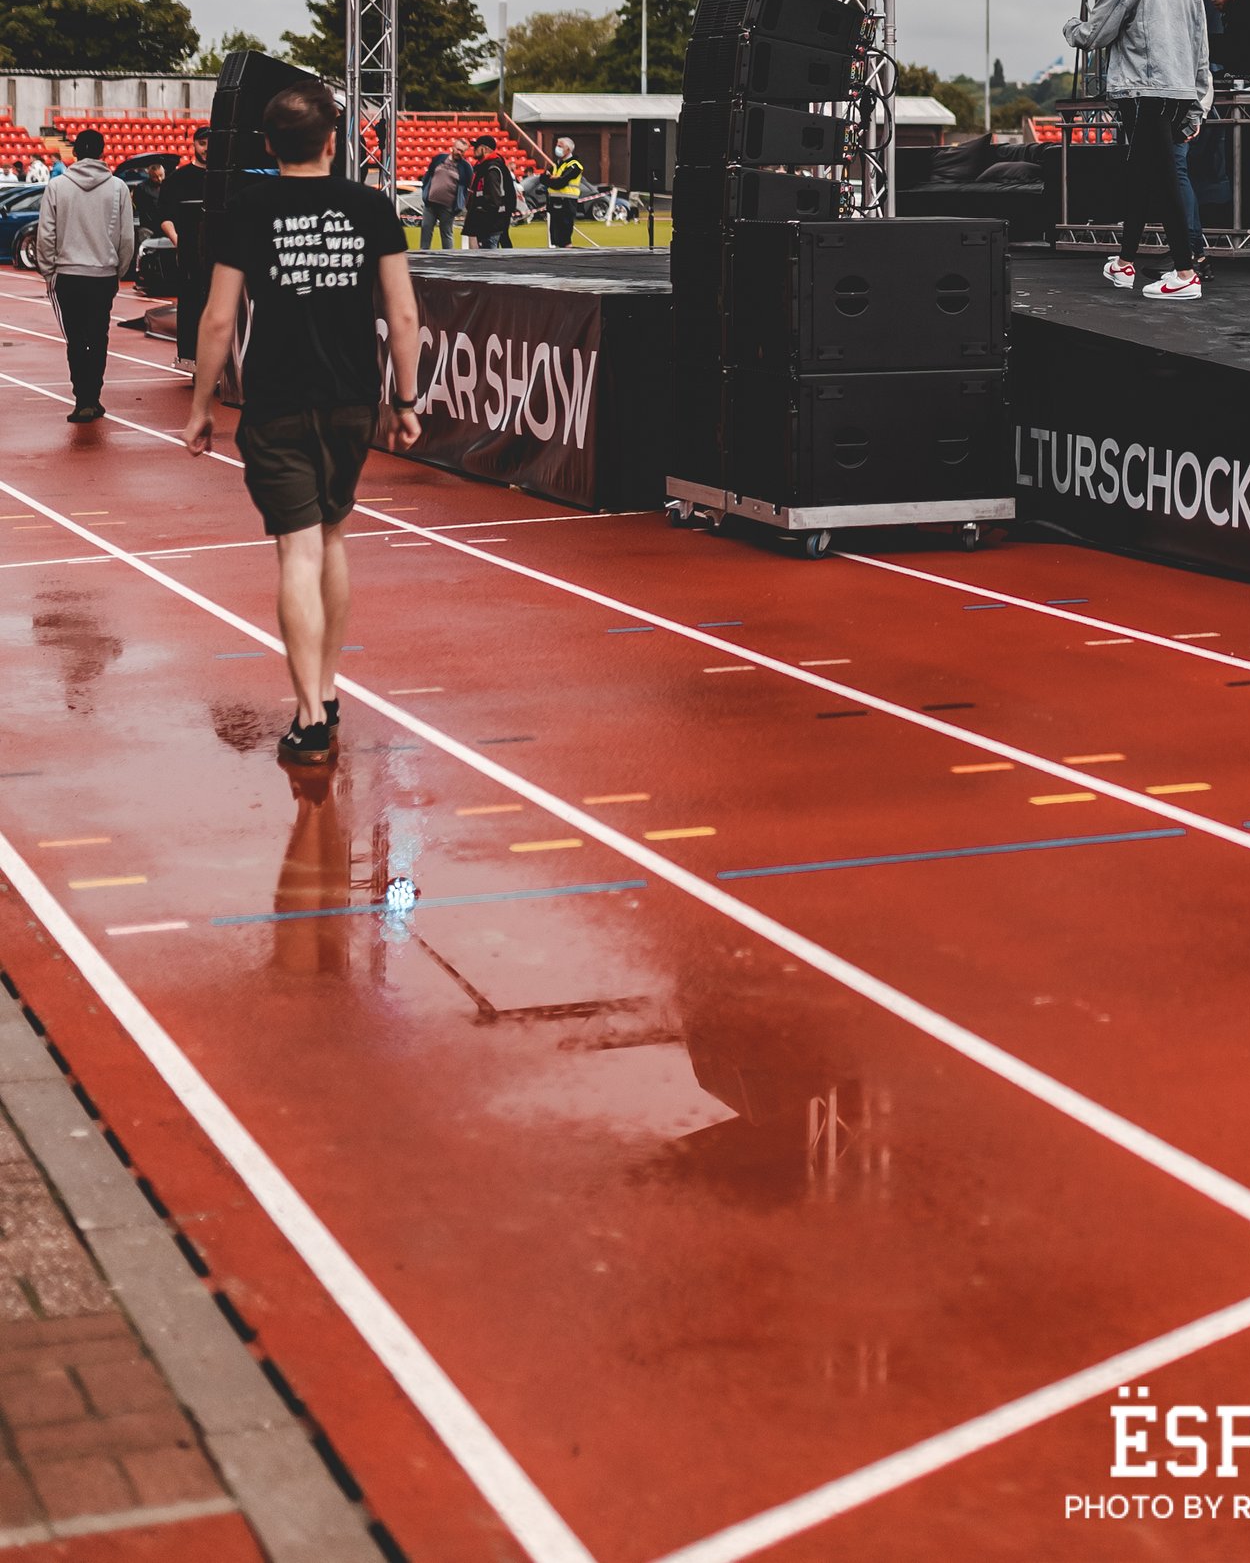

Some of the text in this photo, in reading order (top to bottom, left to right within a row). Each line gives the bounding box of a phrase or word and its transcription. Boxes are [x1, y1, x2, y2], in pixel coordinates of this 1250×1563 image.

[285, 215, 354, 232] NOT ALL
[272, 234, 365, 250] THOSE WHO
[278, 253, 354, 267] WANDER
[280, 270, 358, 287] ARE LOST
[484, 334, 598, 450] SHOW
